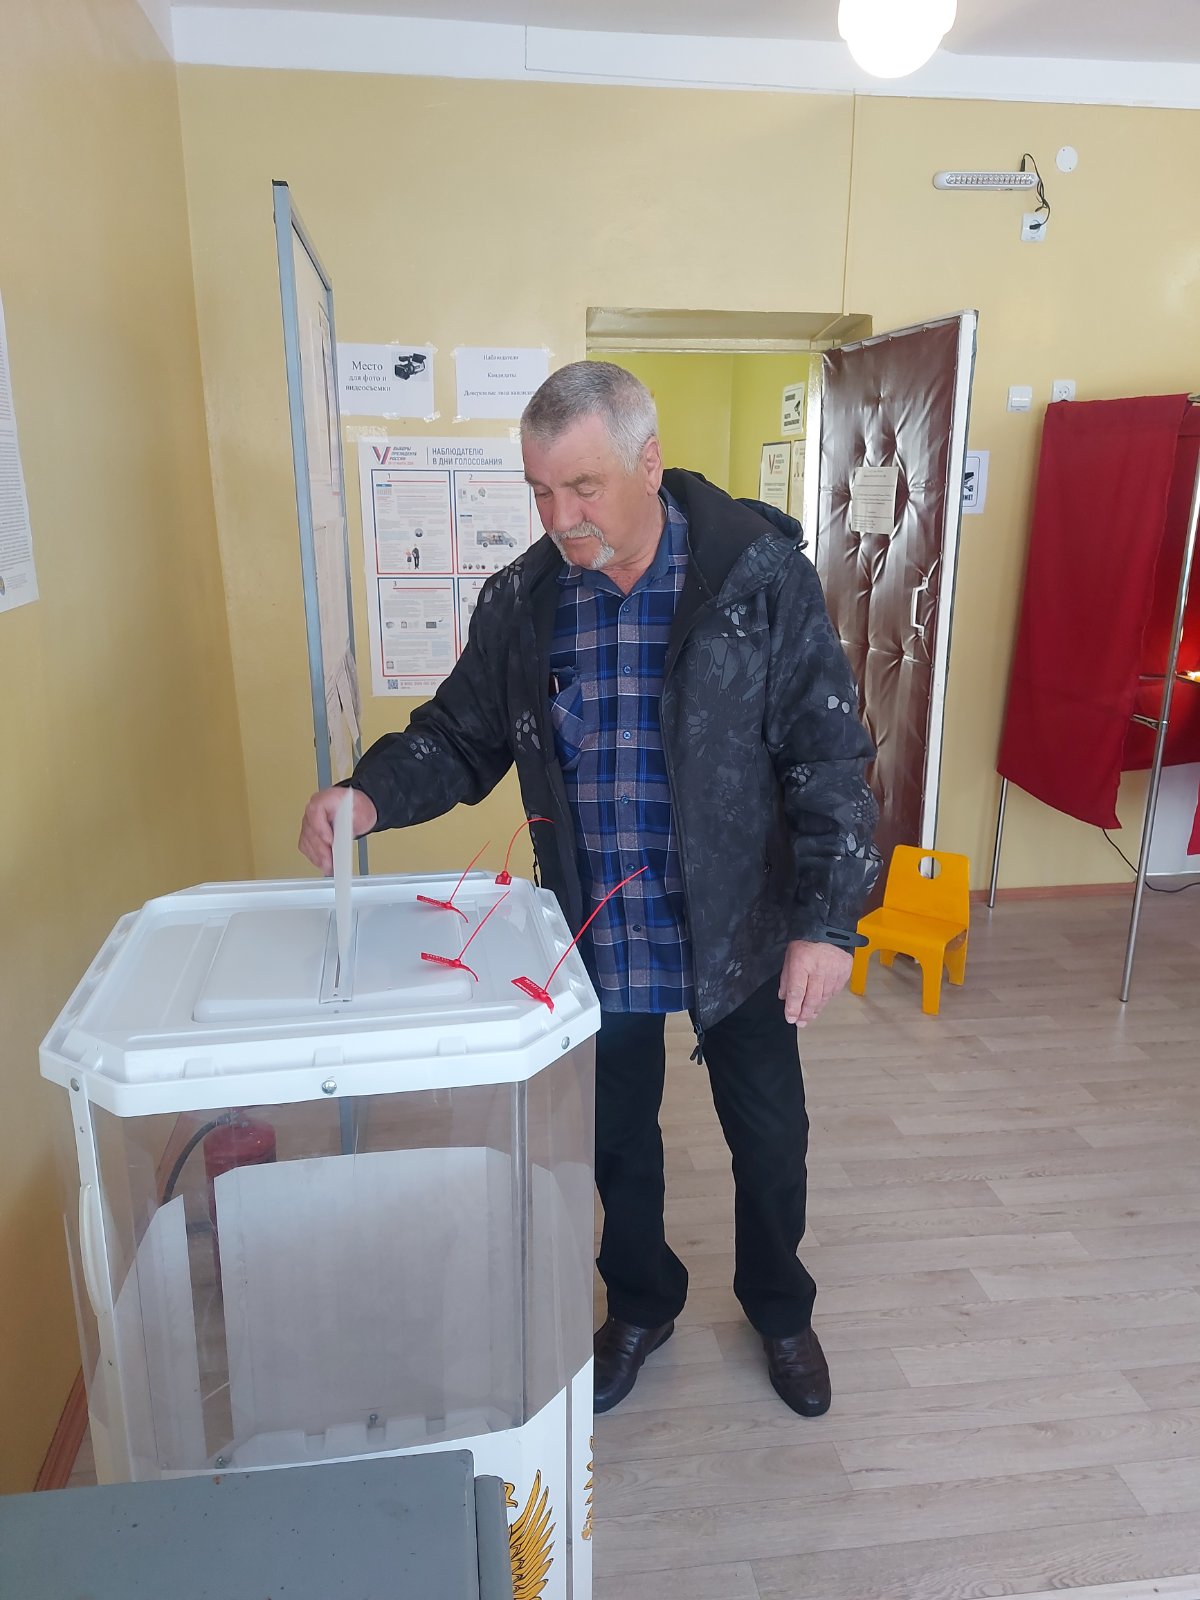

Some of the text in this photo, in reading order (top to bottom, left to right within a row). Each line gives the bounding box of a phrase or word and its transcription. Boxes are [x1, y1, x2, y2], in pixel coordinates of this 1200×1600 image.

[352, 361, 383, 371] Место
[362, 374, 381, 383] фото
[432, 447, 484, 456] НАБЛЮДАТЕЛЮ
[438, 458, 453, 466] ДНИ
[454, 457, 503, 466] ГОЛОСОВАНИЯ
